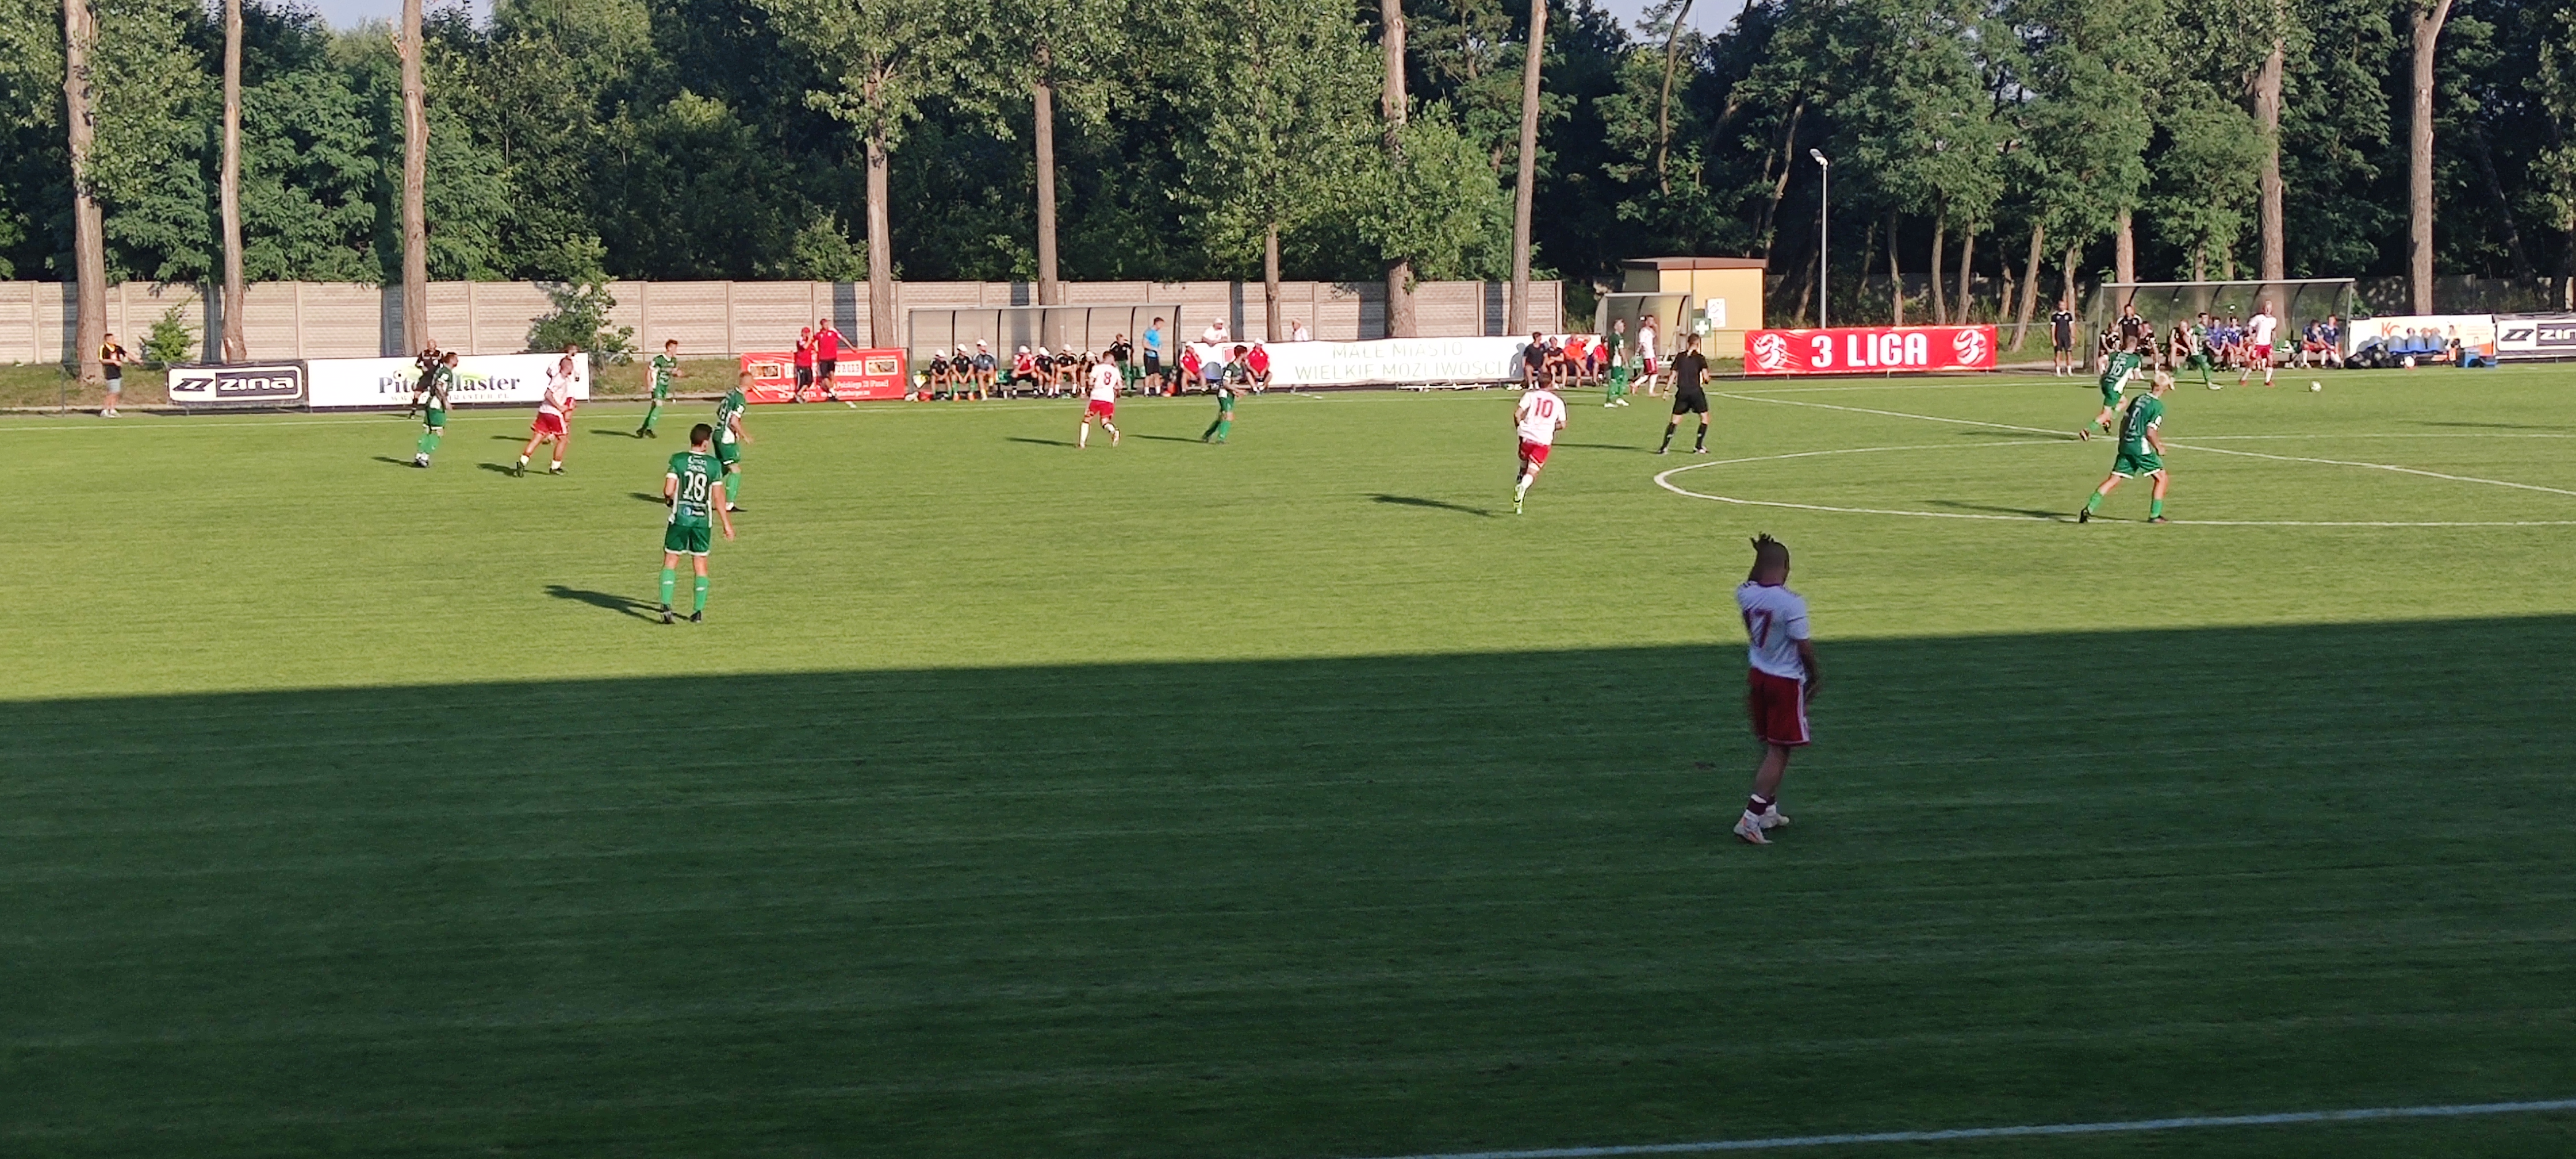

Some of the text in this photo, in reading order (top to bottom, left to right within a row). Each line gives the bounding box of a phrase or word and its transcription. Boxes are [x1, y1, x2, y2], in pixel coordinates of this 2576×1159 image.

[2540, 328, 2576, 340] zin
[1391, 341, 1463, 358] MIASTO
[1811, 333, 1927, 367] 3 LIGA
[2110, 360, 2126, 375] 16
[220, 377, 295, 391] zina
[1104, 370, 1112, 386] 8
[1534, 397, 1554, 418] 10
[683, 471, 708, 502] 28
[1743, 608, 1773, 648] 17
